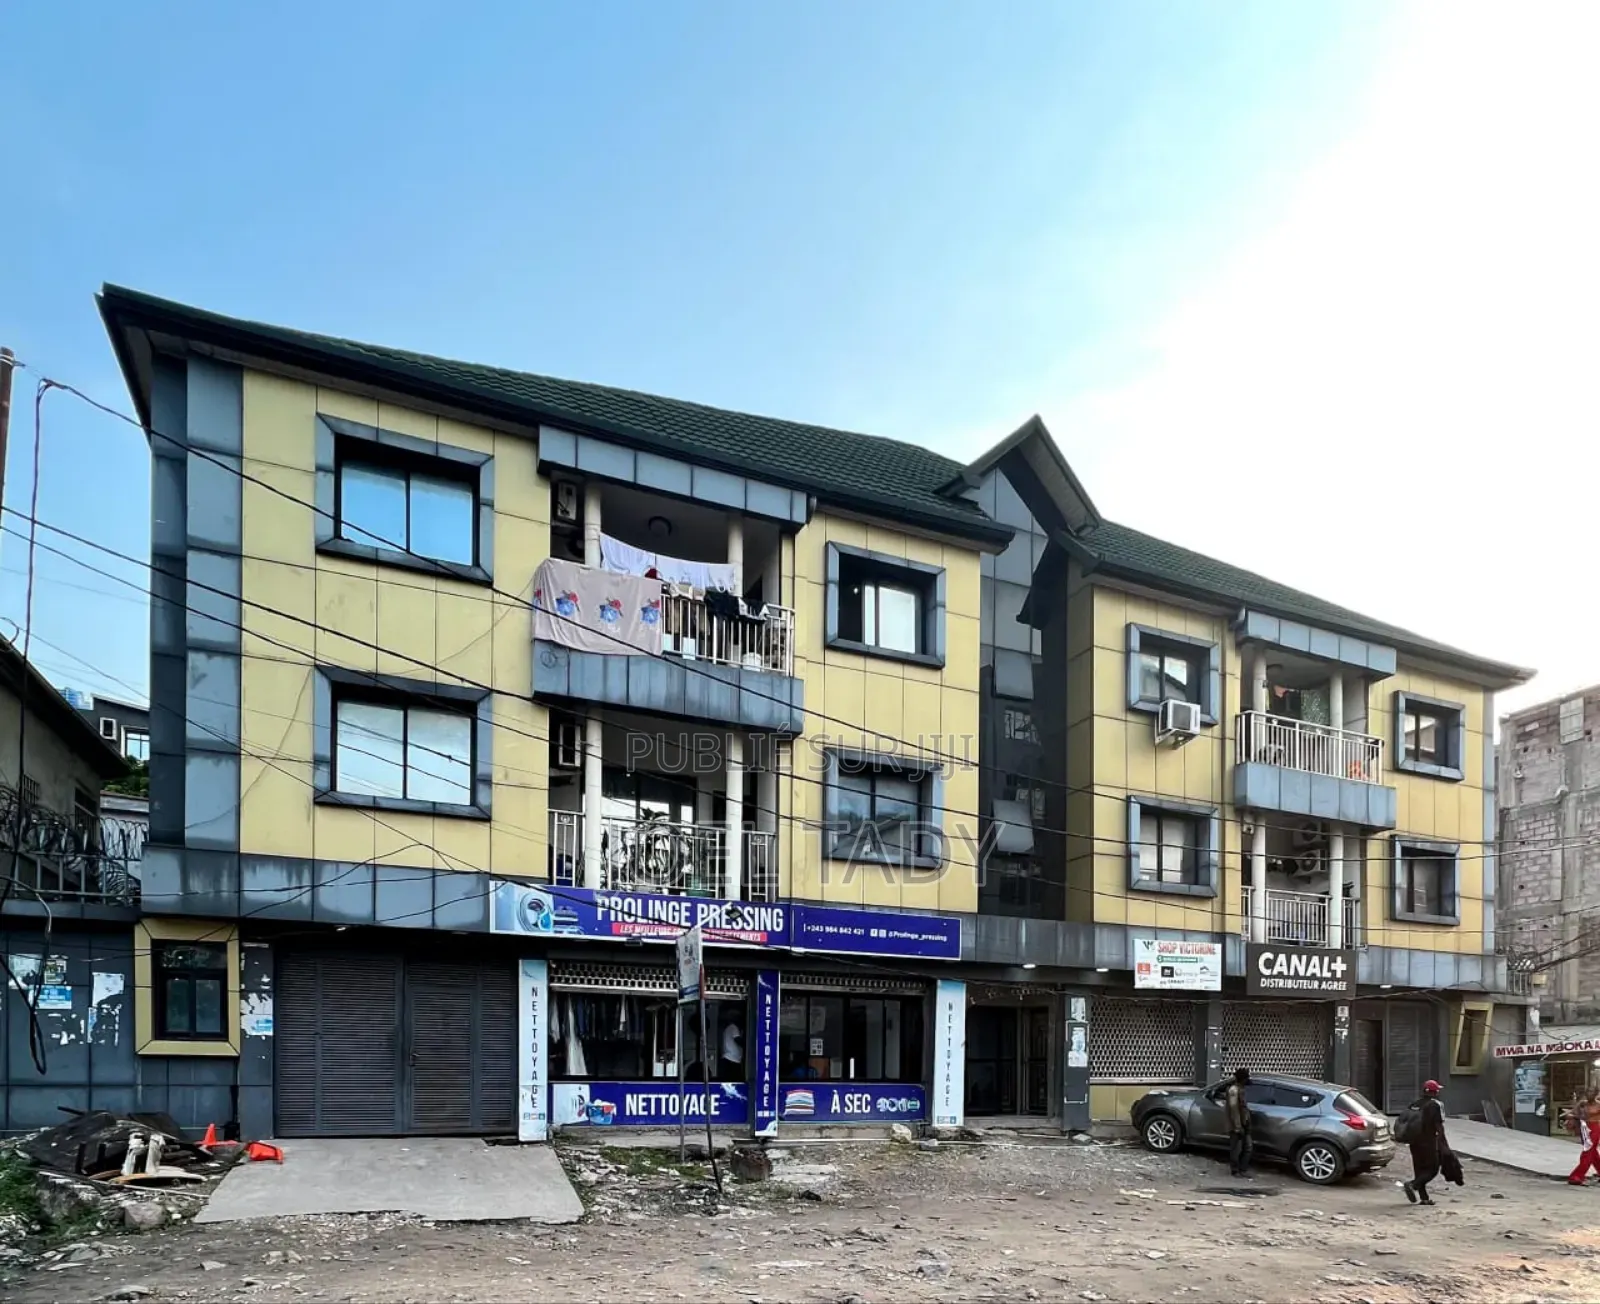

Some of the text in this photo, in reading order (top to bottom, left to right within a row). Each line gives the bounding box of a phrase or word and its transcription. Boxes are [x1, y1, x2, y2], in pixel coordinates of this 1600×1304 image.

[596, 896, 784, 932] PROLINGE PRESSING
[1258, 951, 1347, 978] CANAL+
[1260, 977, 1320, 990] DISTRIBUTEUR
[531, 986, 539, 1109] NETTOYAGE
[763, 993, 772, 1107] NETTOYAGE
[945, 1002, 954, 1107] NETTOYAGE
[831, 1089, 871, 1114] À SEC
